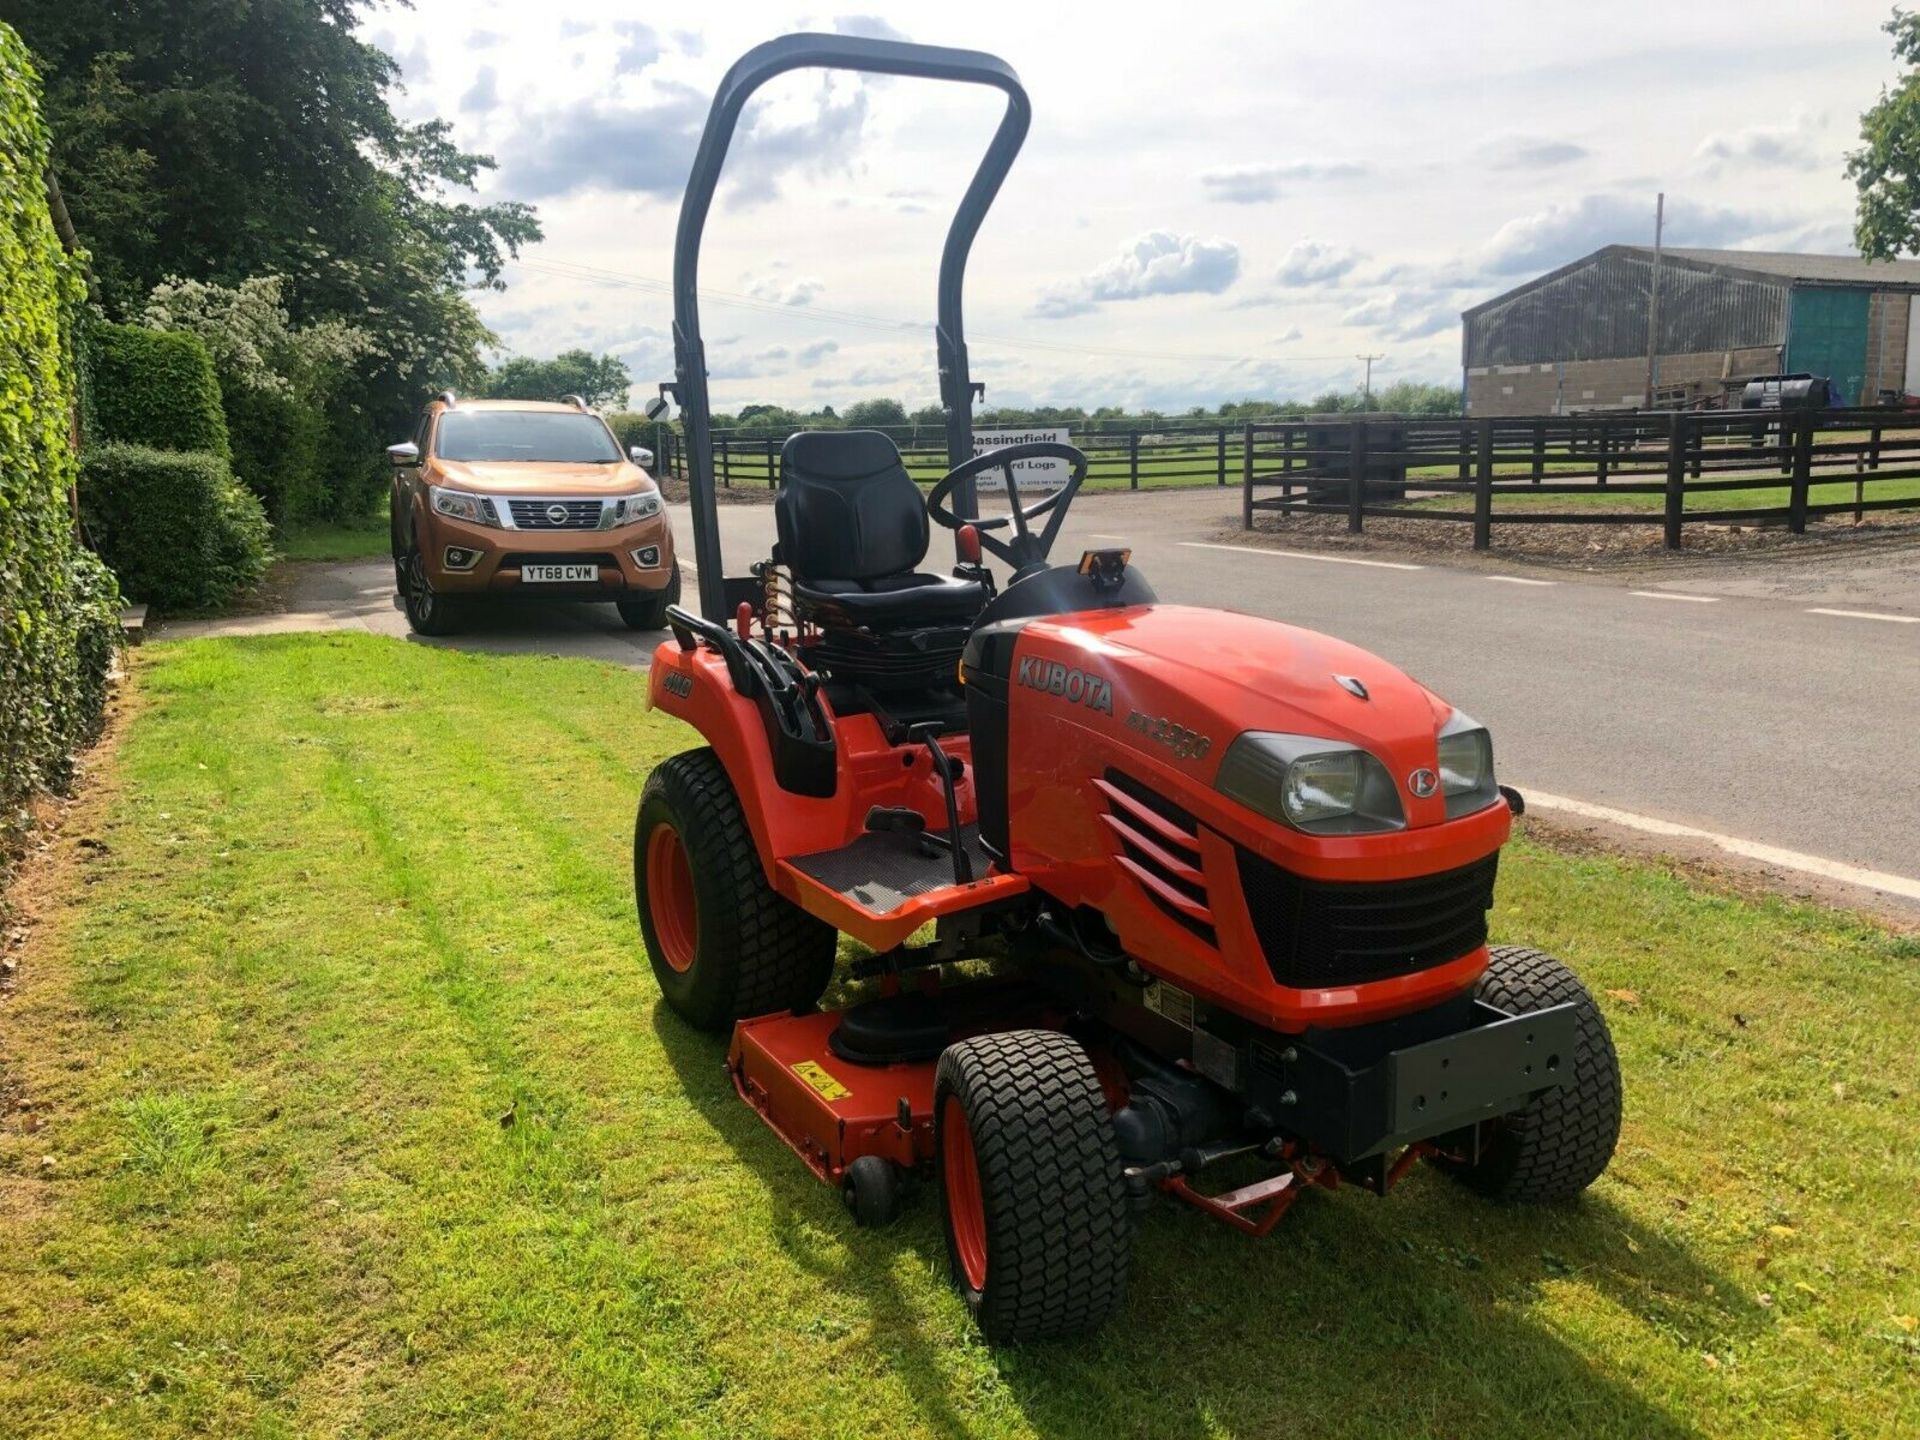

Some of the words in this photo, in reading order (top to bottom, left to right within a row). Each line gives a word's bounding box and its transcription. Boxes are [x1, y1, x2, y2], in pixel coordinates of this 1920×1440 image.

[1028, 460, 1057, 470] Logs
[527, 567, 562, 579] YT68
[566, 567, 592, 579] CVM
[1018, 655, 1113, 717] KUBOTA
